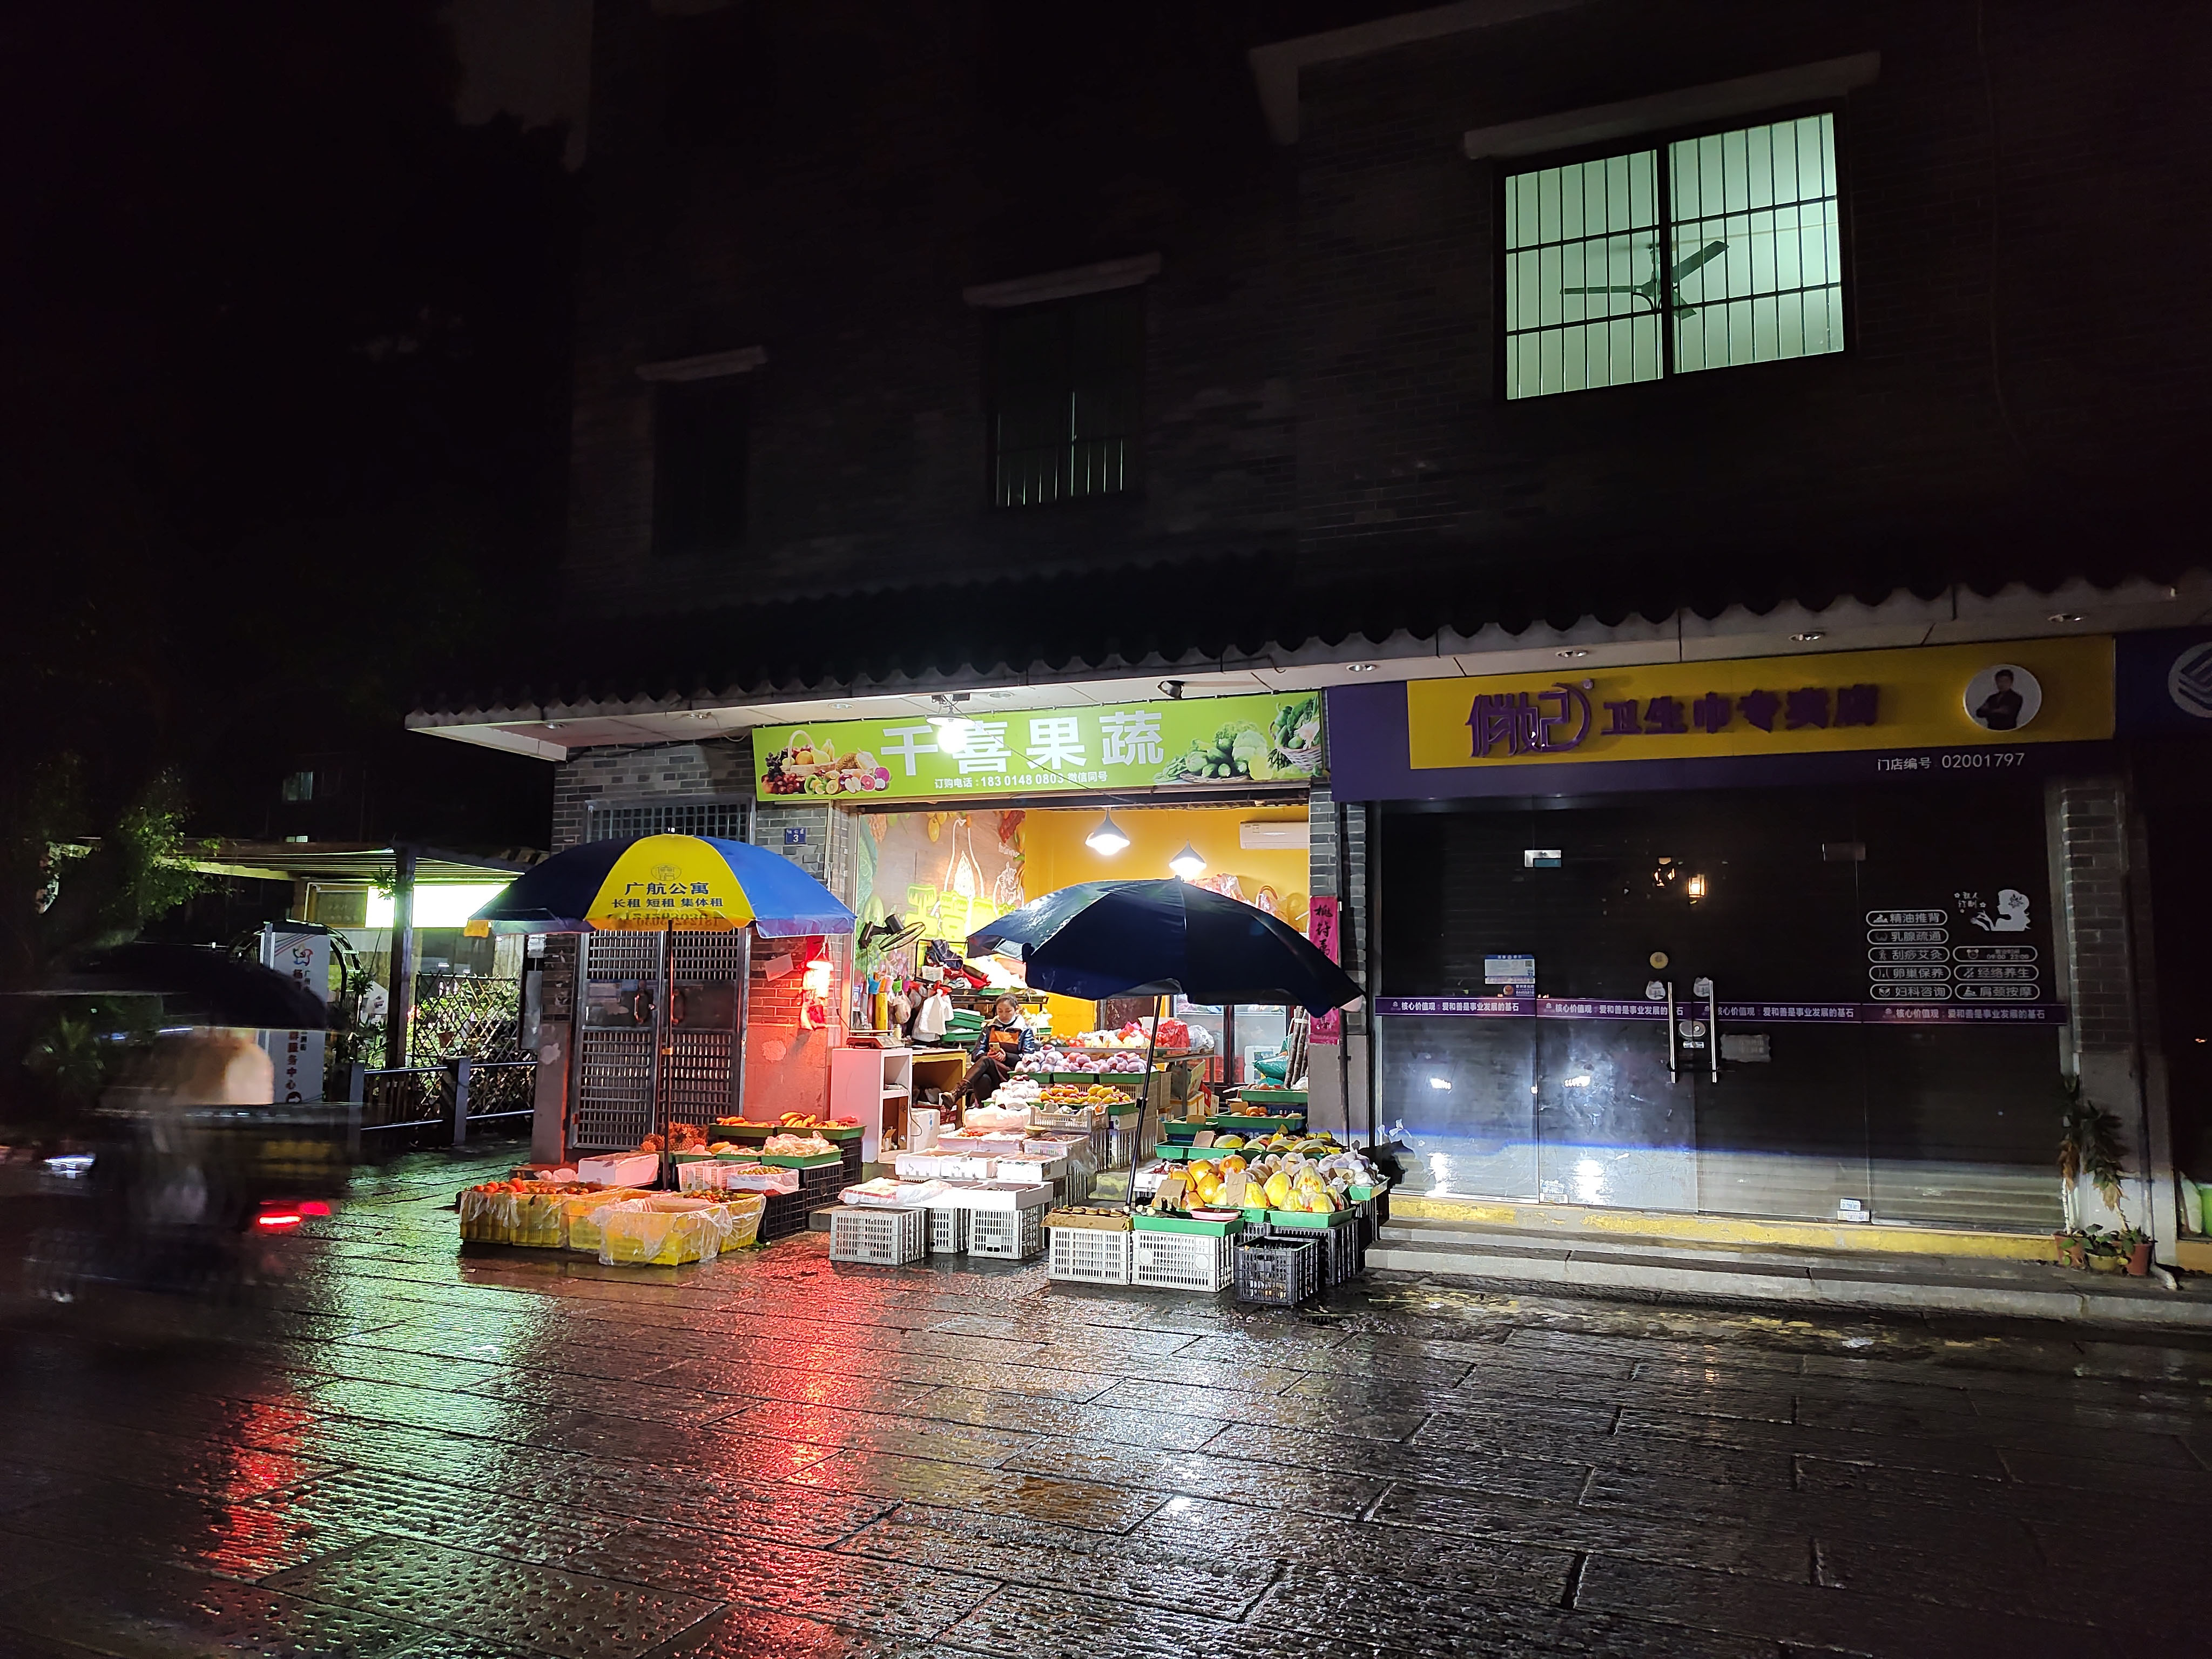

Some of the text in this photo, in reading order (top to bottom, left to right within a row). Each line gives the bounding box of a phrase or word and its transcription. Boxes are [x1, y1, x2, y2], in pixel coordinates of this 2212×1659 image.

[881, 710, 1164, 775] 千喜果蔬
[1877, 753, 2025, 771] 门店编号 02001797
[981, 777, 1001, 787] 183
[1004, 775, 1033, 786] 0148
[1035, 773, 1064, 785] 0803
[1067, 771, 1108, 783] 微信同号
[793, 834, 799, 842] 3
[624, 882, 709, 895] 广航公寓
[611, 898, 724, 908] 长租 短租 集体租
[1890, 914, 1940, 924] 精油推背
[1891, 932, 1941, 942] 乳腺疏通
[1892, 950, 1943, 960] 刮痧艾灸
[1893, 968, 1944, 979] 卵巢保养
[1977, 968, 2031, 979] 经络养生
[1894, 987, 1946, 997] 妇科咨询
[1979, 987, 2032, 997] 肩颈按摩
